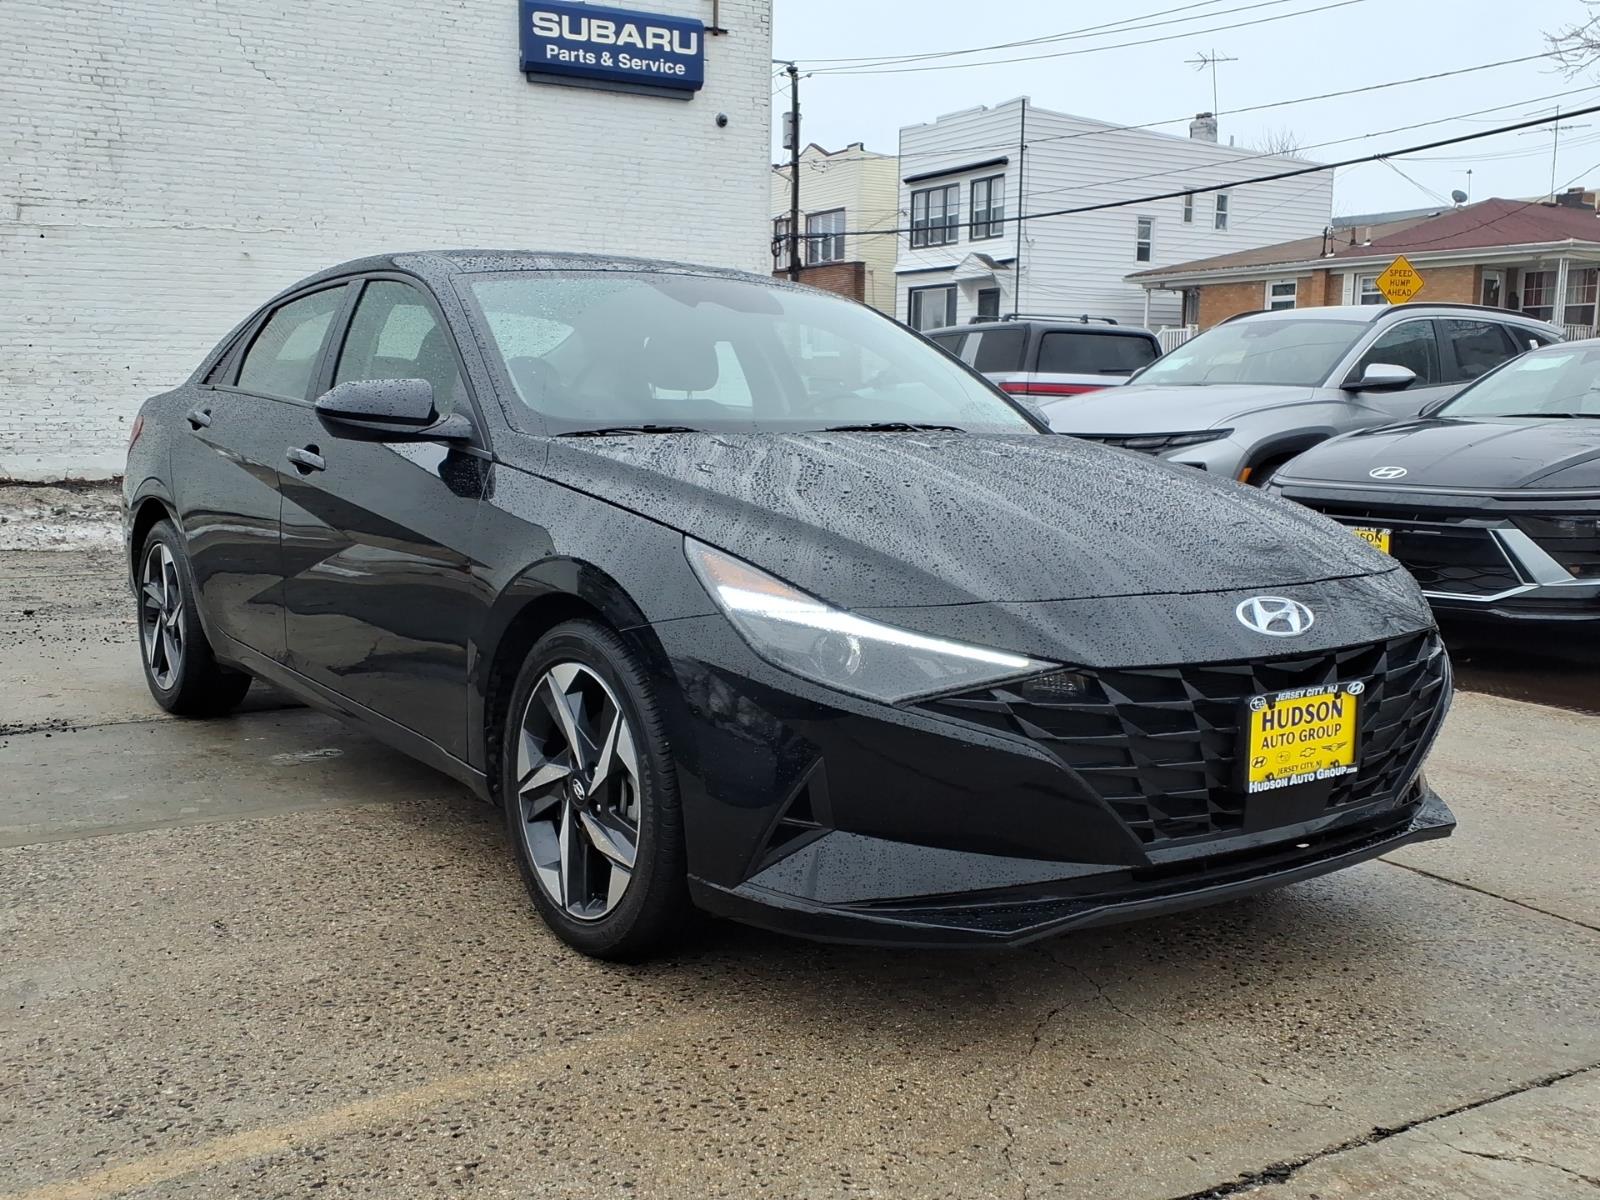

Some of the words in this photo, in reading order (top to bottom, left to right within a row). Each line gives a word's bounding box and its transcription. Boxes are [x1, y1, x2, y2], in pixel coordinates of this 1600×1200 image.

[532, 11, 697, 55] SUBARU
[546, 44, 596, 64] Parts
[600, 51, 614, 67] &
[618, 53, 686, 75] Service
[1389, 269, 1413, 277] SPEED
[1390, 279, 1411, 287] HUMP
[1387, 288, 1412, 297] AHEAD
[1276, 690, 1305, 701] JERSEY
[1327, 685, 1338, 694] NJ
[1262, 698, 1343, 732] HUDSON
[1261, 731, 1295, 750] AUTO
[1299, 723, 1342, 743] GROUP
[1277, 764, 1299, 776] JERSEY
[1315, 759, 1323, 769] NJ
